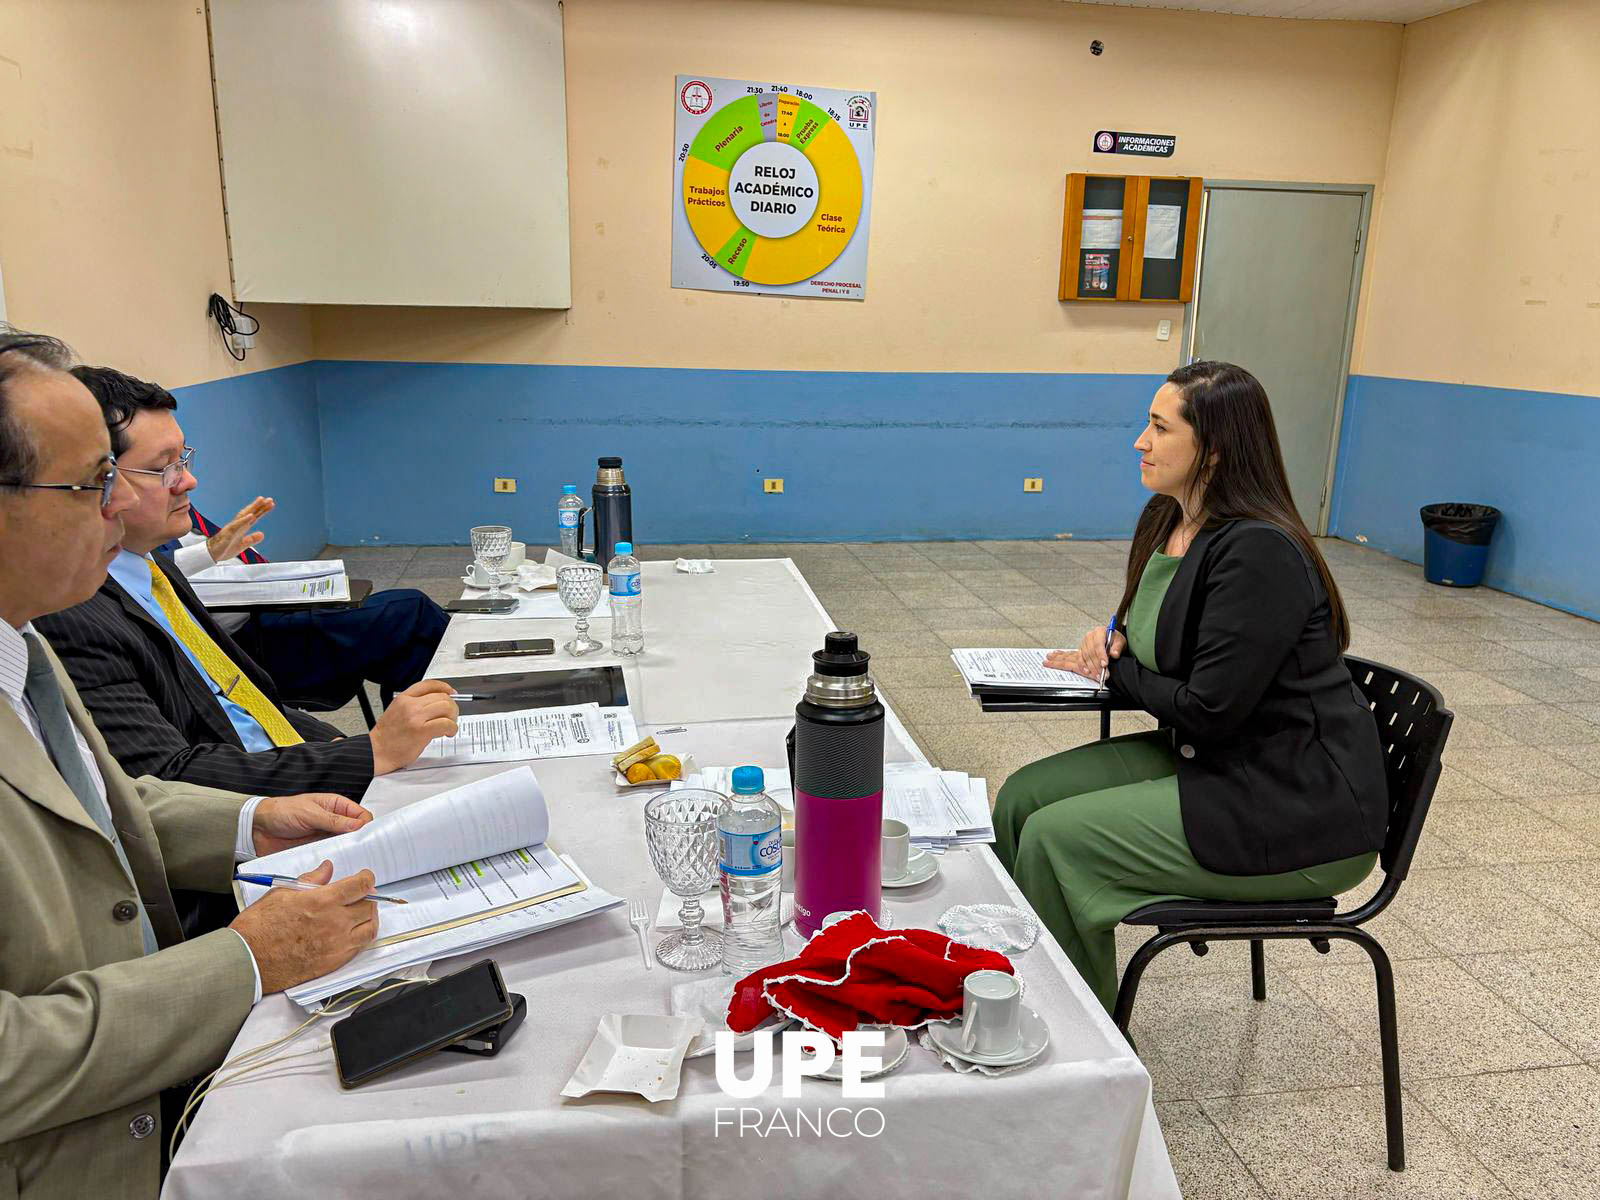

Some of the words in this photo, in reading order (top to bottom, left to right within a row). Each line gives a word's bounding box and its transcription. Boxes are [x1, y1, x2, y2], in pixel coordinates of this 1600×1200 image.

[747, 86, 764, 94] 21:30
[771, 85, 788, 93] 21:40
[796, 89, 813, 100] 18:00
[827, 107, 841, 122] 18:15
[796, 118, 814, 139] Prueba
[799, 121, 819, 145] Express
[714, 125, 743, 152] Plenaria
[1118, 136, 1175, 147] INFORMACIONES
[1122, 143, 1169, 153] ACADÉMICAS
[754, 165, 796, 180] RELOJ
[689, 185, 726, 197] Trabajos
[734, 181, 814, 199] ACADÉMICO
[687, 196, 726, 208] Prácticos
[750, 200, 797, 215] DIARIO
[820, 213, 843, 223] Clase
[817, 224, 846, 234] Teórica
[727, 238, 747, 265] Receso
[701, 253, 718, 270] 20:05
[733, 280, 750, 288] 19:50
[835, 281, 862, 289] PROCESAL
